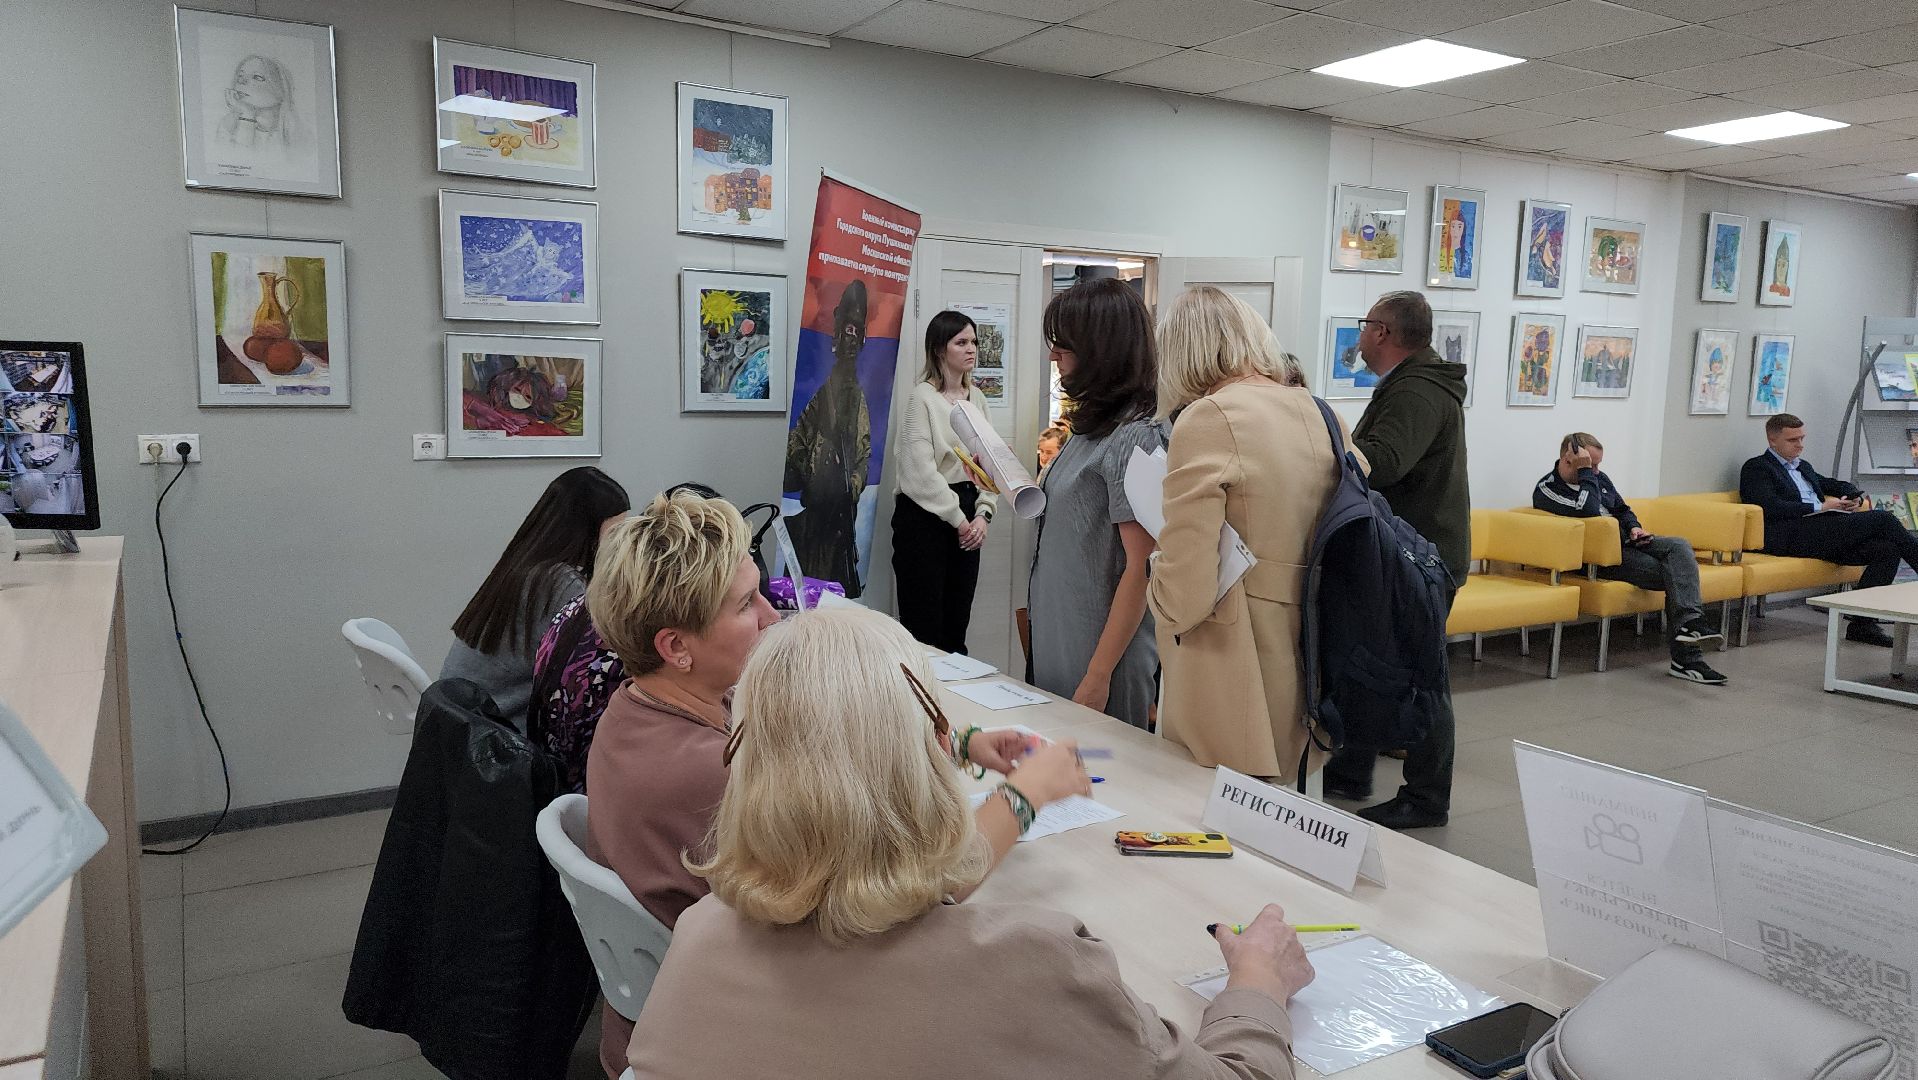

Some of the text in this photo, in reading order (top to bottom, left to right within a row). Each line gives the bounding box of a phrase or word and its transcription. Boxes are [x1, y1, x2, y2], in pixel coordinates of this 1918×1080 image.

[861, 244, 894, 262] Московской
[858, 264, 876, 278] службу
[1220, 782, 1350, 849] РЕГИСТРАЦИЯ
